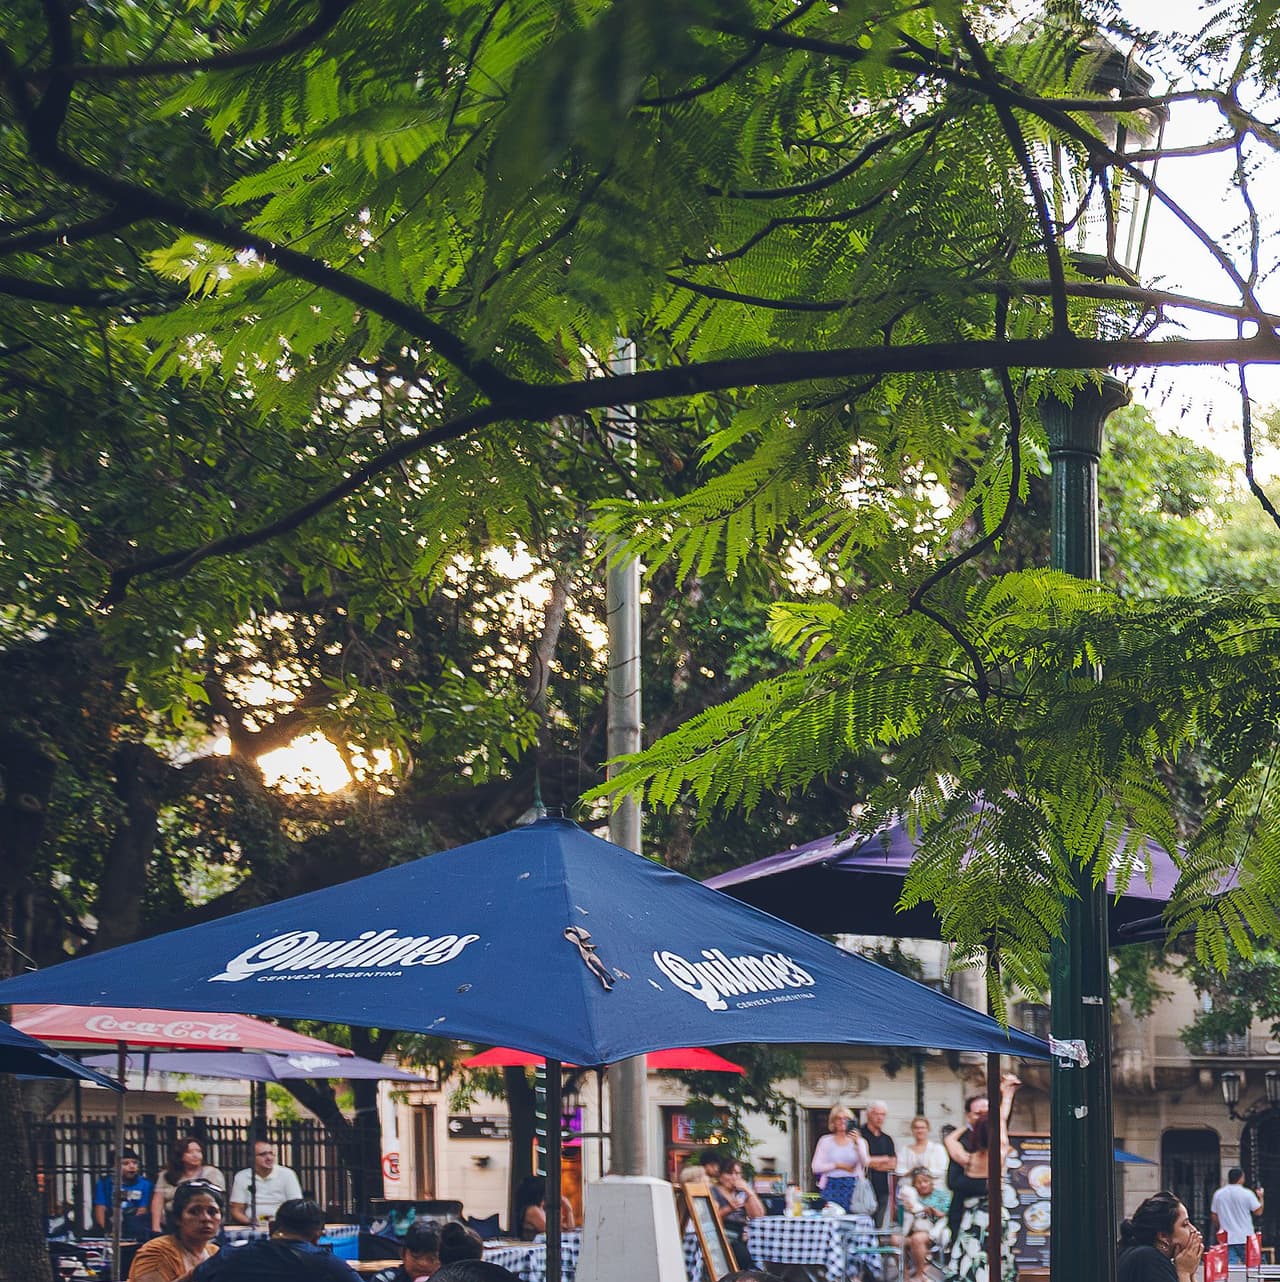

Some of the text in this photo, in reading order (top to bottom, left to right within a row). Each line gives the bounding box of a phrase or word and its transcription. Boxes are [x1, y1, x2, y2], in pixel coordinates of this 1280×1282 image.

[208, 929, 480, 982] Quilmes
[257, 970, 403, 982] CERVEZA ARGENTINA
[653, 948, 816, 1012] Quilmes
[85, 1014, 241, 1042] Coca-Cola
